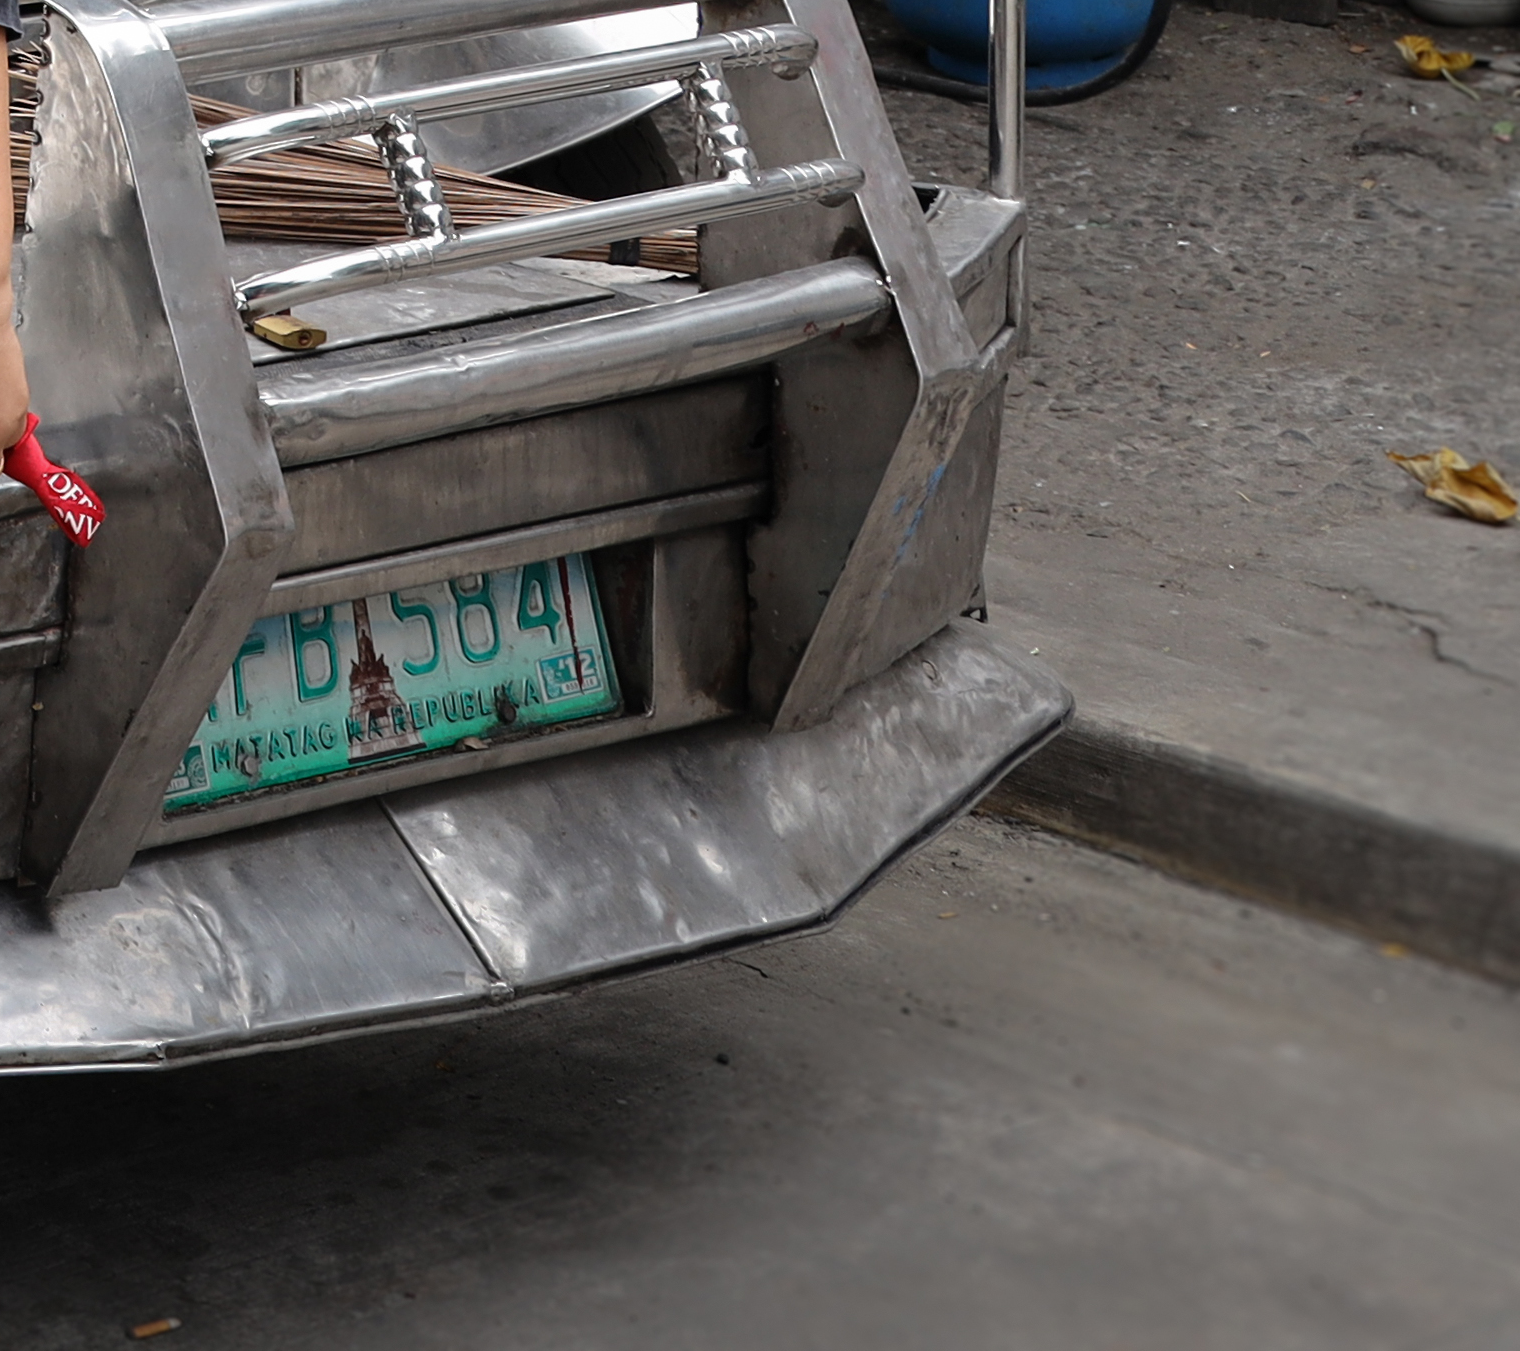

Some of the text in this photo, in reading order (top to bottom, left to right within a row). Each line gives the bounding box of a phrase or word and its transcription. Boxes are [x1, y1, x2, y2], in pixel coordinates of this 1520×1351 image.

[389, 561, 562, 677] 584
[210, 722, 335, 774] MATATAG
[390, 678, 541, 735] REPUBLIKA
